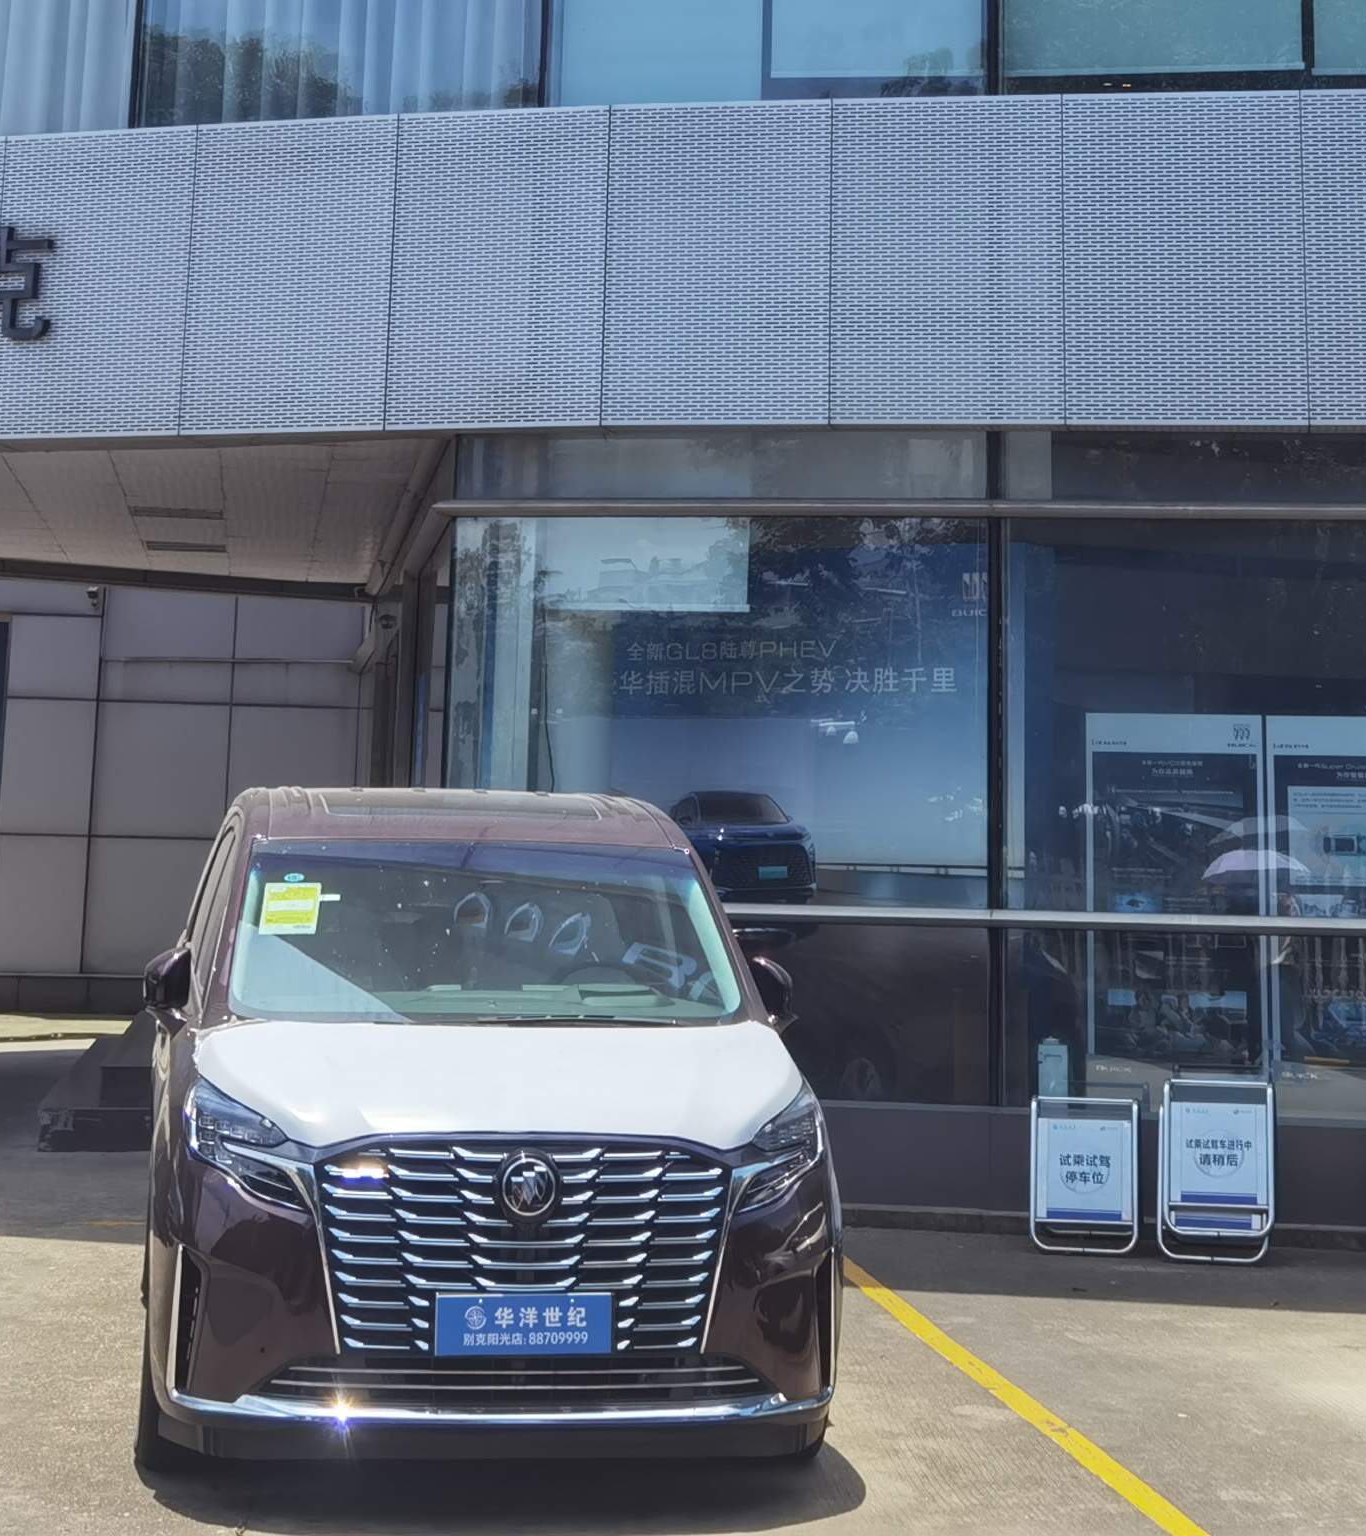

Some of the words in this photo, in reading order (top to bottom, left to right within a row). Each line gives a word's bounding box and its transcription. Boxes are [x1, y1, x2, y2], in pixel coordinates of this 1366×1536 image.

[612, 667, 835, 696] 华插混MPV之势
[845, 667, 957, 693] 决胜千里
[1059, 1153, 1111, 1168] 试乘试驾
[1199, 1153, 1239, 1167] 请稍后
[1065, 1171, 1105, 1185] 停车位
[494, 1306, 588, 1328] 华洋世纪
